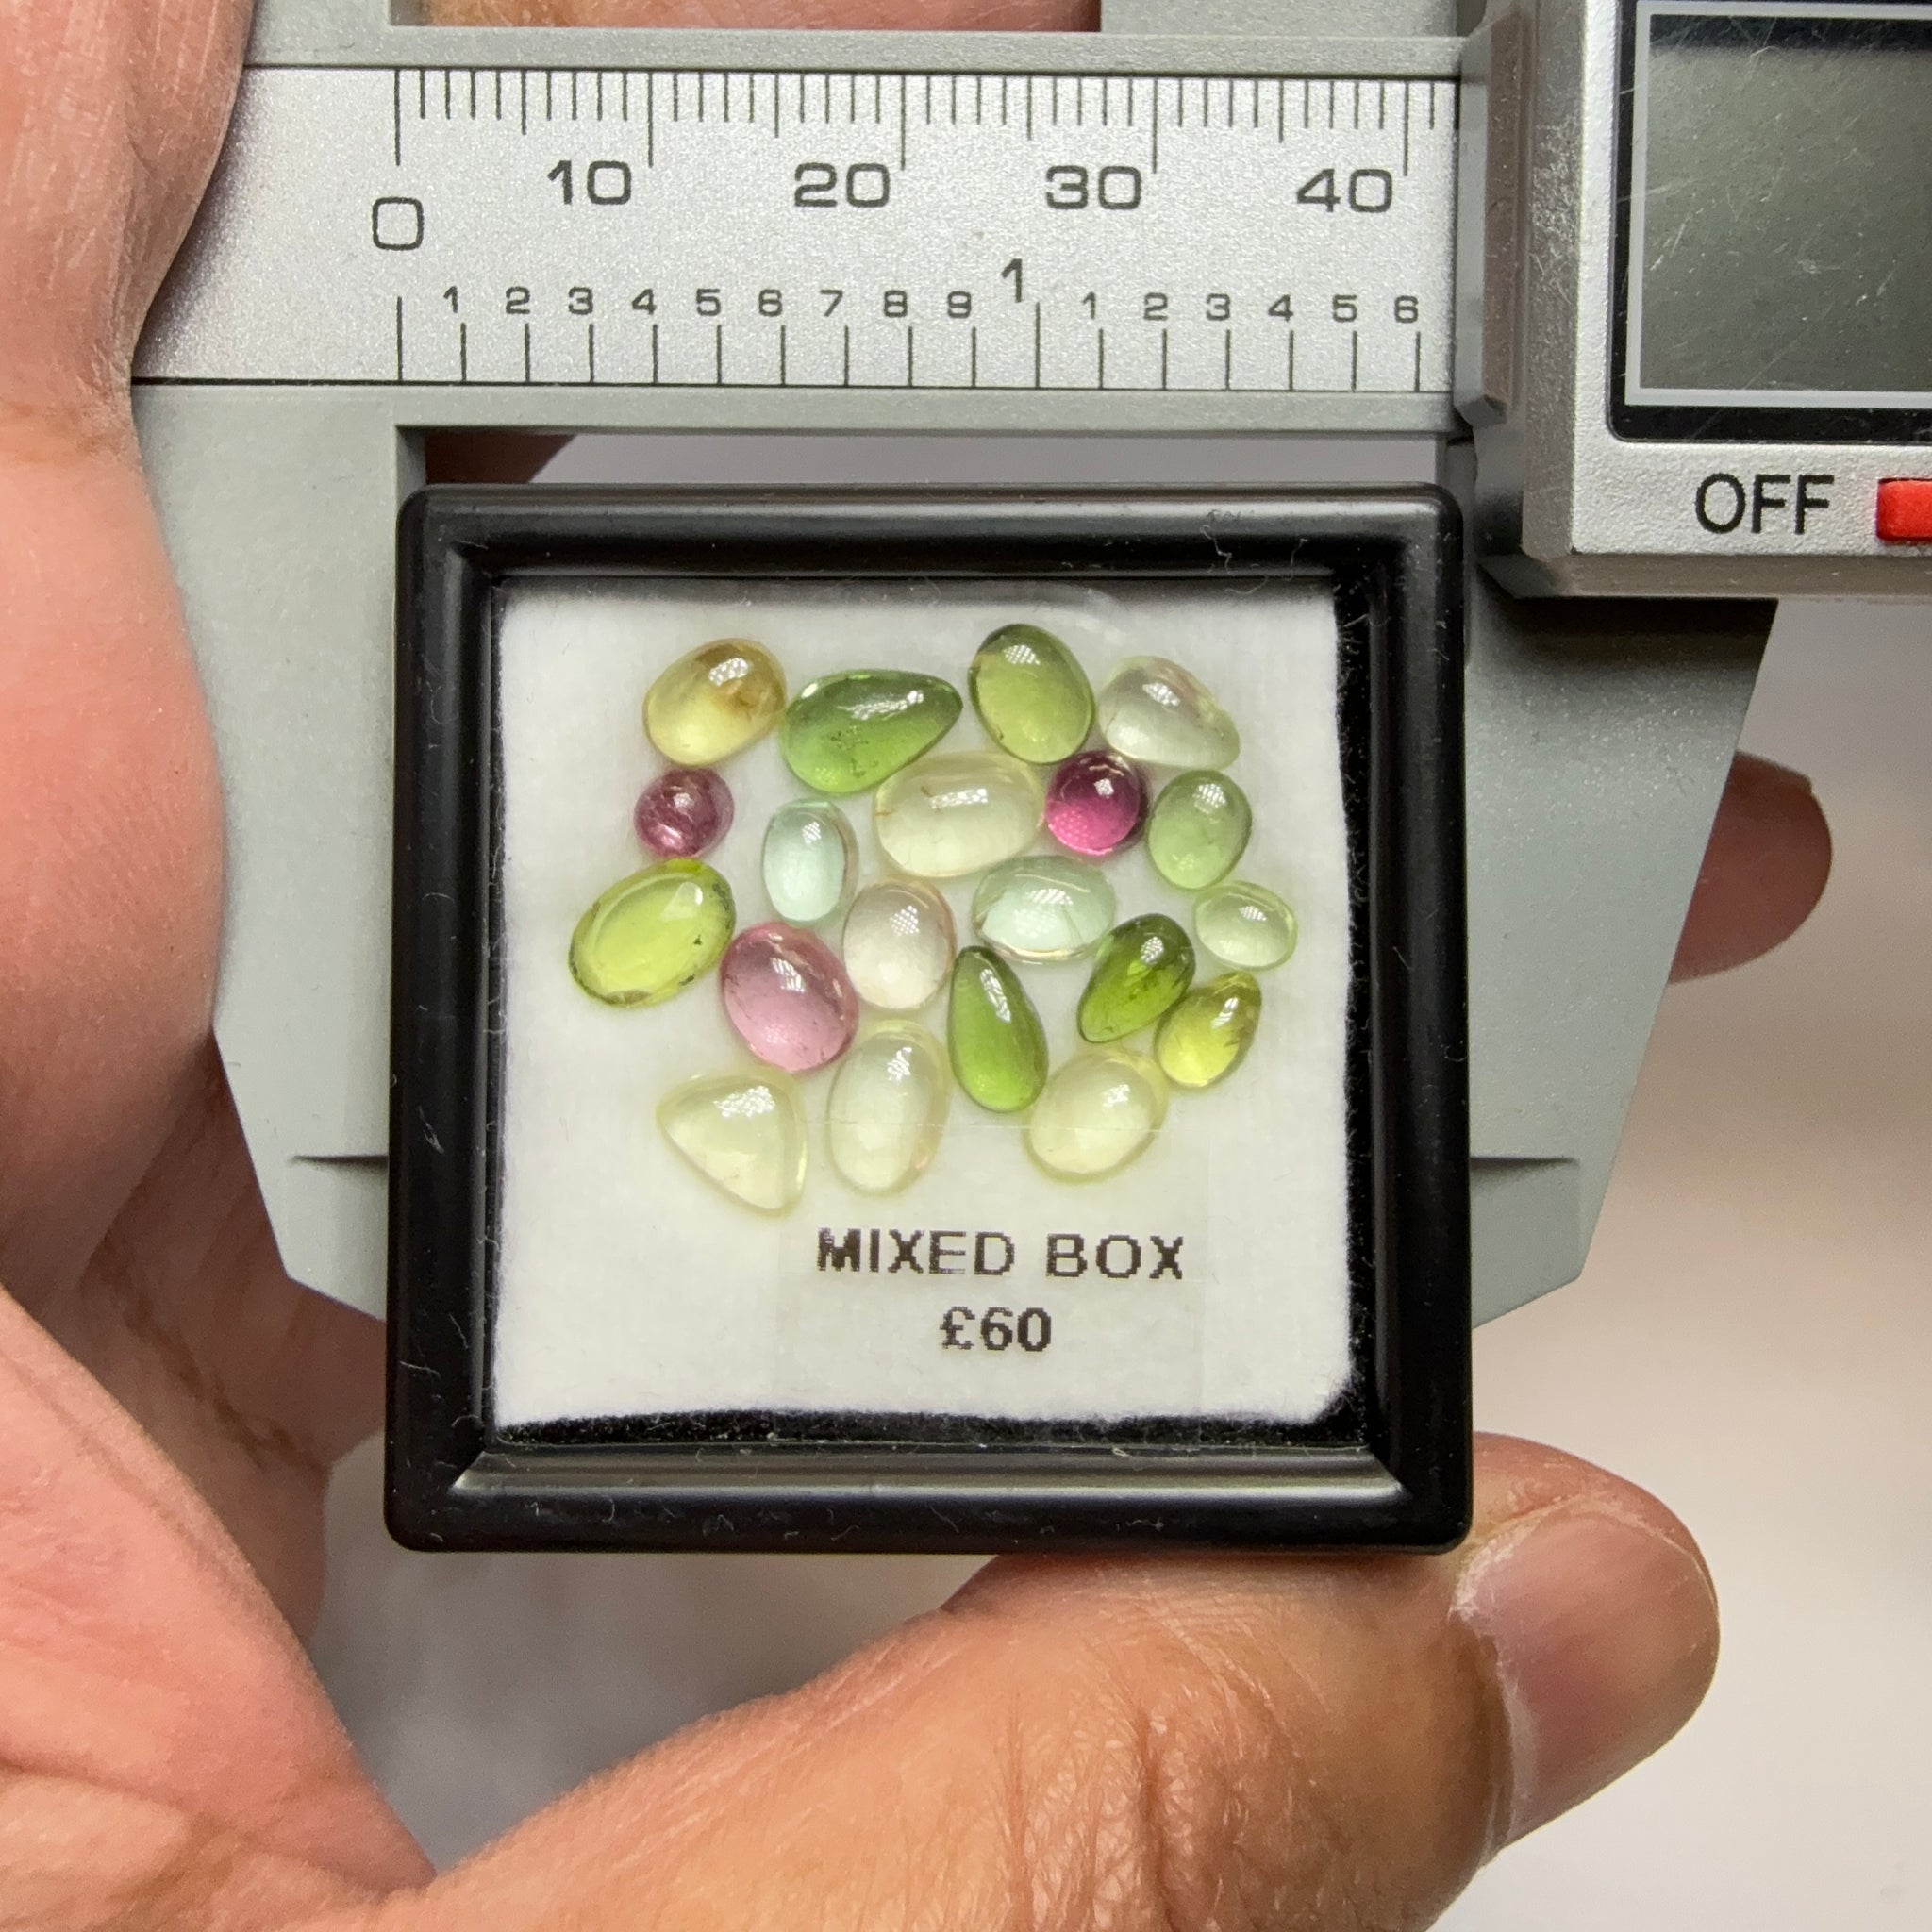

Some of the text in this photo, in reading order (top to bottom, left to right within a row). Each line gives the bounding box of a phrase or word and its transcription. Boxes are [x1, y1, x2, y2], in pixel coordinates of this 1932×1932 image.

[547, 160, 1393, 213] 10 20 30 40
[372, 196, 425, 251] 0
[442, 258, 1419, 323] 1 2 3 4 5 6 7 8 9 1 1 2 3 4 5 6
[1694, 472, 1835, 535] OFF
[817, 1227, 1184, 1279] MIXED BOX
[939, 1306, 1052, 1352] £60
